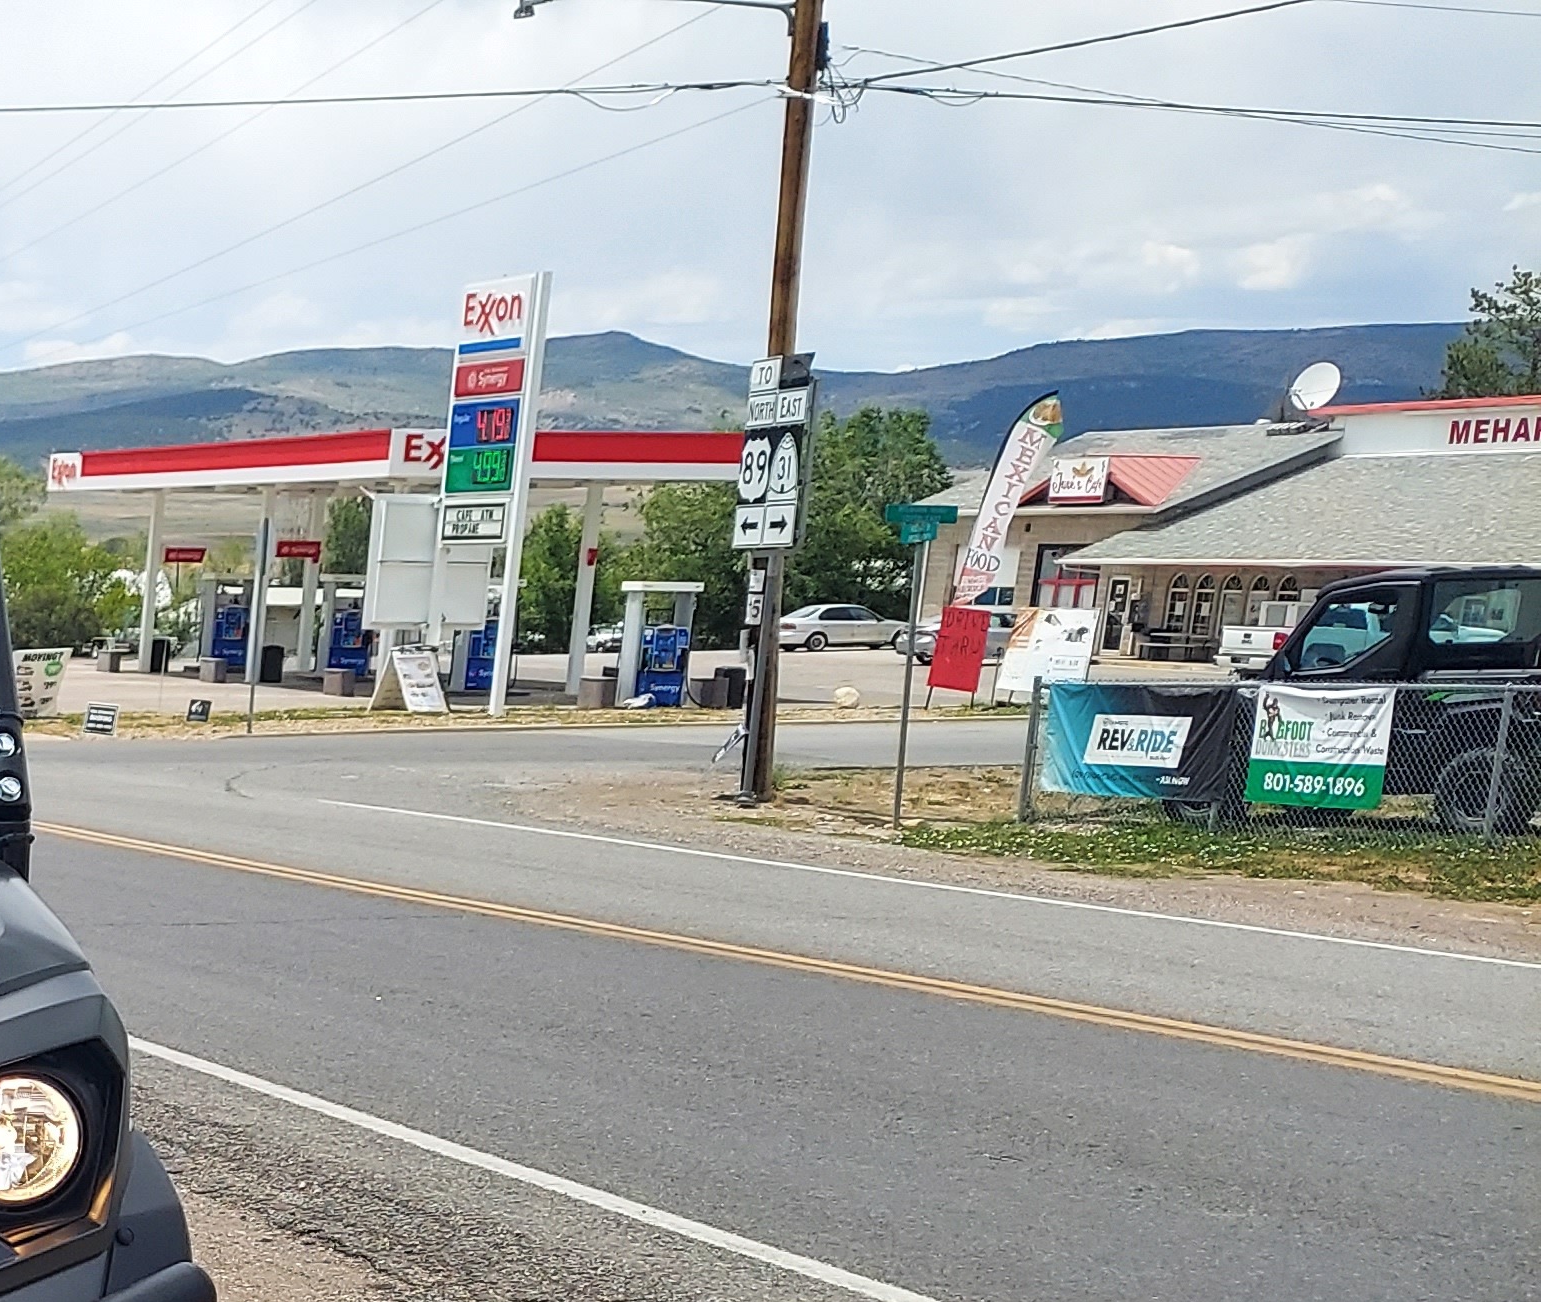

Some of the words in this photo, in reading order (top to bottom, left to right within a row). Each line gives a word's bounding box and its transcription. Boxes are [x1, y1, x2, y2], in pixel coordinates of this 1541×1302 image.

[463, 293, 522, 335] Exxon
[759, 366, 773, 385] TO
[749, 401, 774, 422] NORTH
[780, 397, 803, 419] EAST
[743, 450, 767, 484] 89
[777, 455, 792, 480] 31
[977, 428, 1047, 551] MEXICAN
[457, 510, 473, 521] CAFE
[481, 509, 494, 520] ATM
[965, 551, 1000, 572] FOOD
[22, 652, 64, 662] MOVING?
[1263, 772, 1365, 797] 801-589-1896
